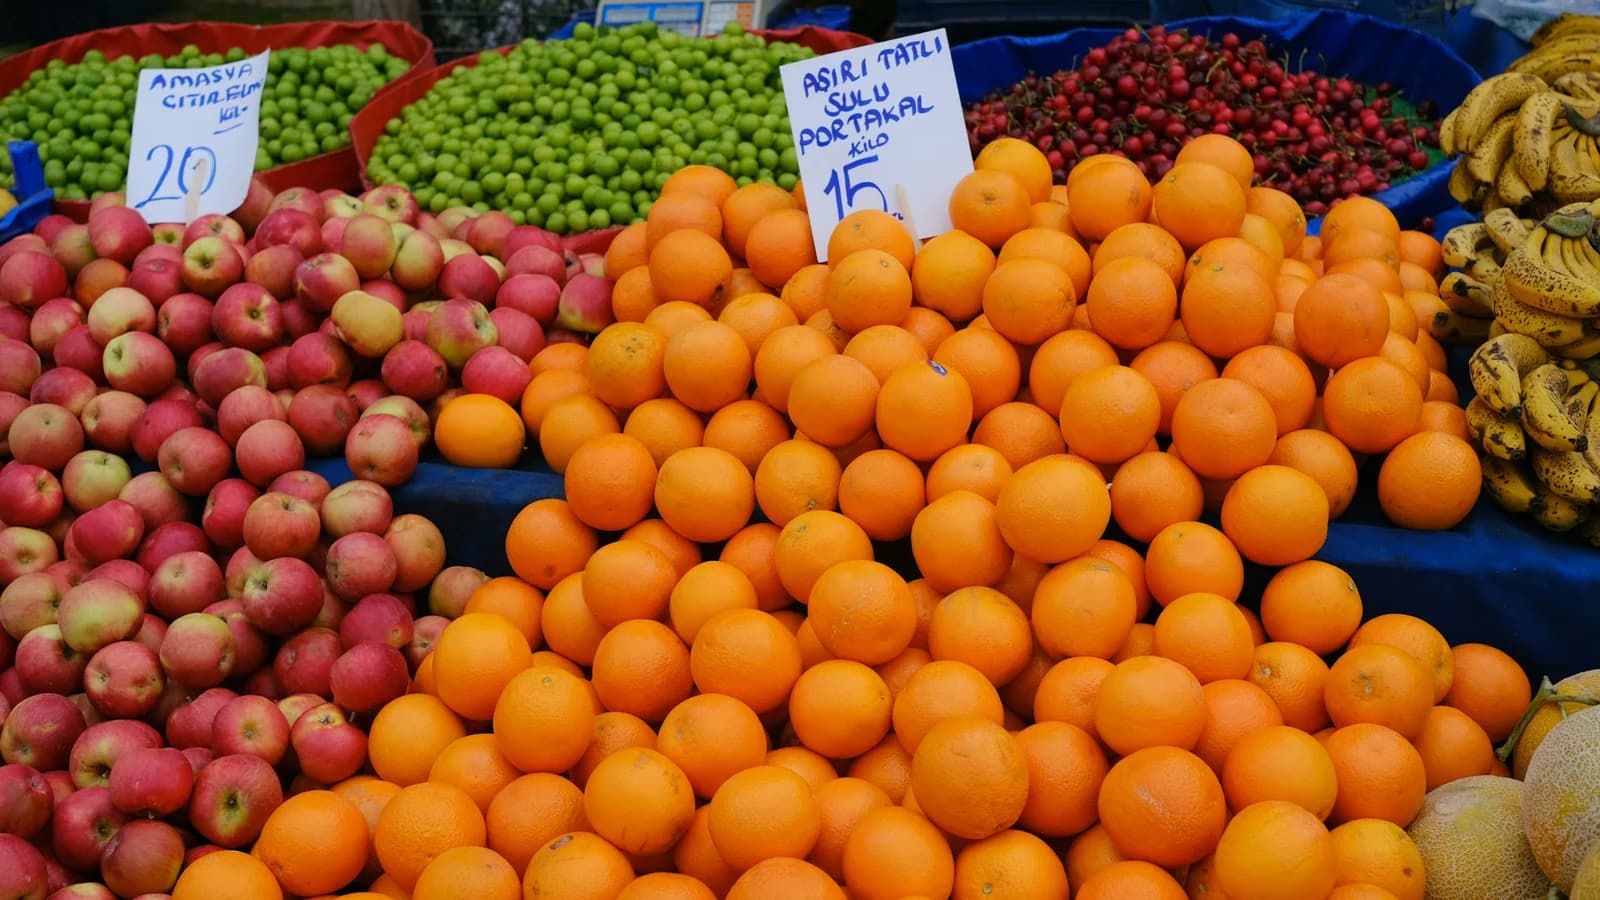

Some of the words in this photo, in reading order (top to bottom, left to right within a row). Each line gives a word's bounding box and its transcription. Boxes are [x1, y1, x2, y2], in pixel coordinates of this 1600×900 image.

[877, 36, 942, 70] TATLI
[799, 95, 935, 156] PORTAKAL
[824, 82, 890, 117] SULU
[134, 143, 217, 209] 20
[823, 154, 889, 221] 15
